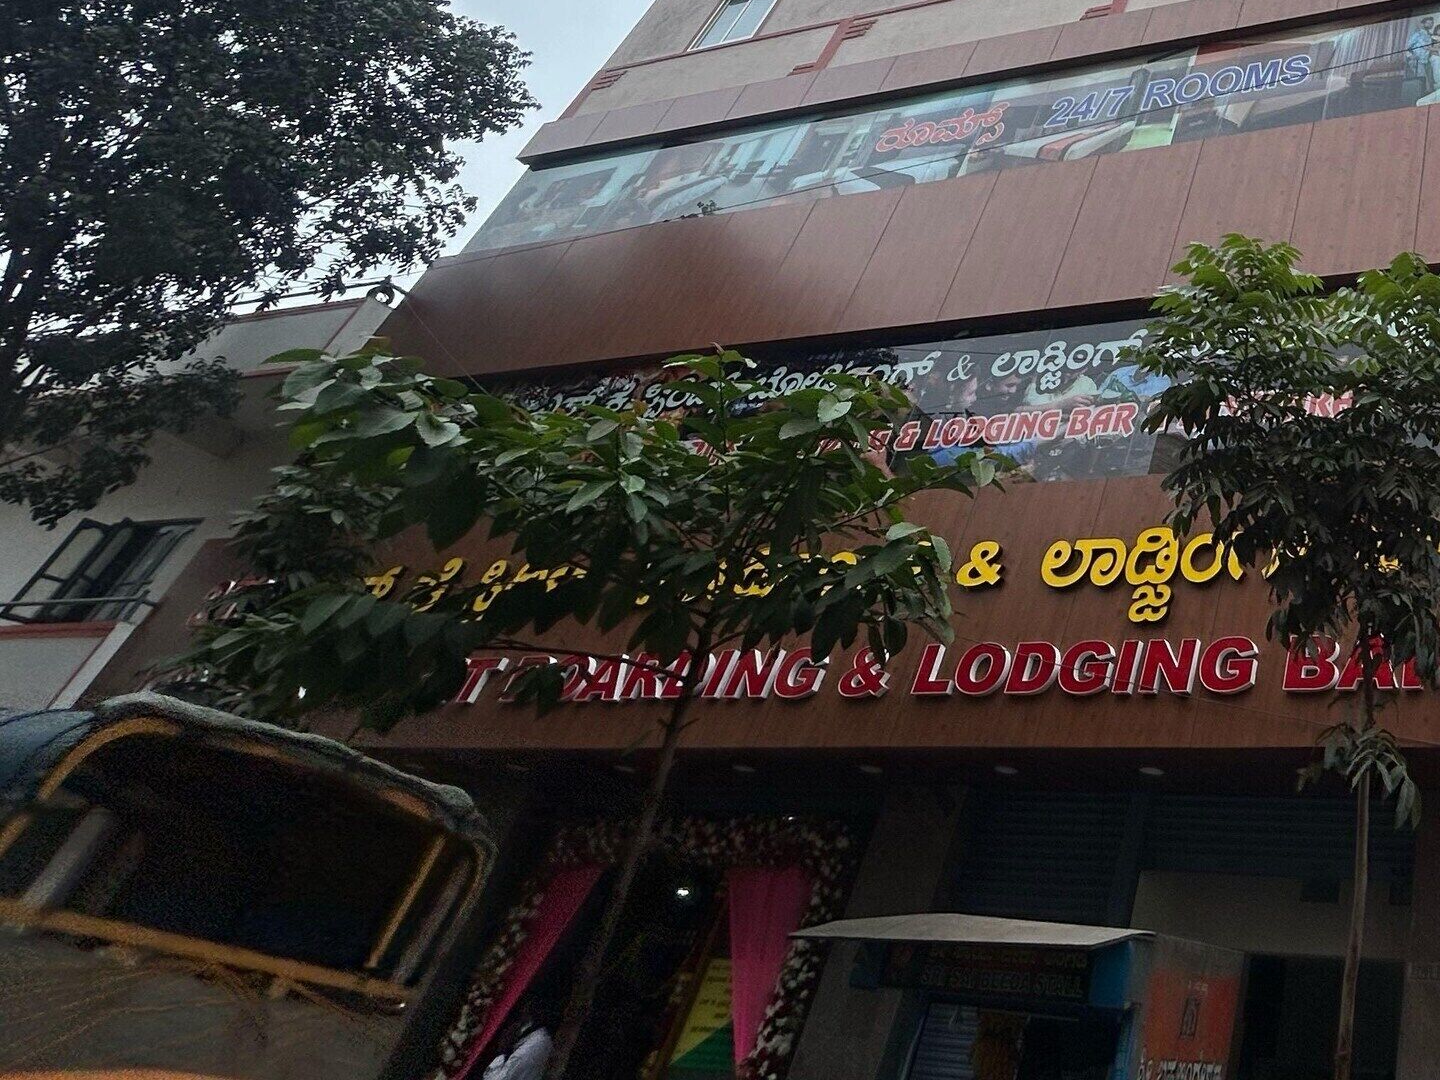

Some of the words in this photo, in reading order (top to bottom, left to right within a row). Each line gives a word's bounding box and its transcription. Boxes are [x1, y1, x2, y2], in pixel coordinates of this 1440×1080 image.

[1044, 85, 1135, 128] 24/7
[1140, 54, 1312, 111] ROOMS
[875, 101, 1010, 150] ರೂಮ್ಸ್
[946, 354, 975, 382] &
[893, 421, 921, 451] &
[922, 409, 1062, 450] LODGING
[1066, 402, 1139, 439] BAR
[956, 541, 1003, 587] &
[834, 644, 891, 698] &
[911, 636, 1260, 697] LODGING
